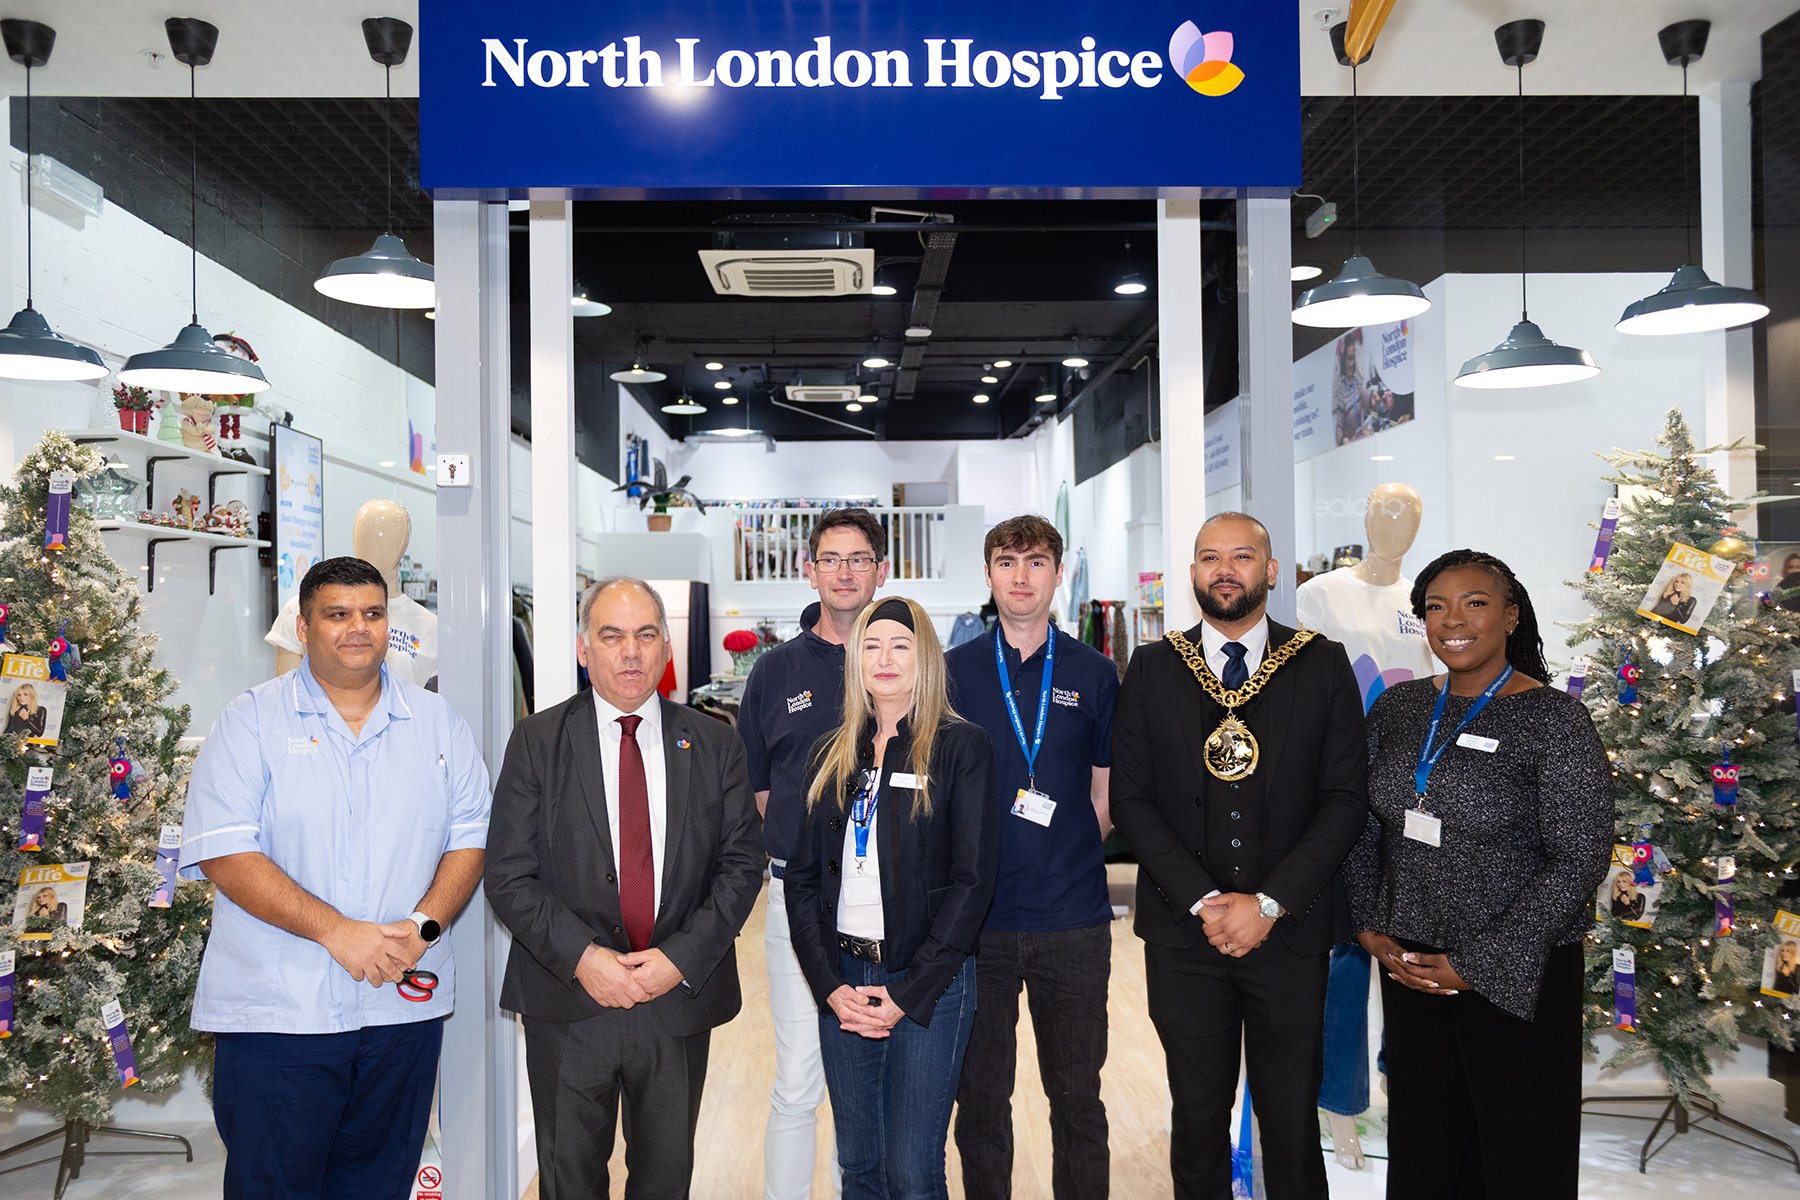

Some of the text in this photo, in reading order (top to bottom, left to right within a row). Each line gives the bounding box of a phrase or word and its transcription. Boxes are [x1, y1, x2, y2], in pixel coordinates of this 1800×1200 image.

[482, 34, 1163, 100] North London Hospice
[1382, 325, 1401, 343] North
[1382, 338, 1407, 357] London
[1383, 350, 1407, 370] Hospice
[390, 628, 409, 640] orth
[1400, 626, 1425, 638] Hosp
[392, 636, 416, 651] ndon
[787, 693, 804, 703] North
[1053, 687, 1071, 697] North
[1053, 691, 1078, 702] London
[788, 697, 810, 708] London
[788, 702, 812, 713] Hospice
[1053, 697, 1079, 706] Hospice
